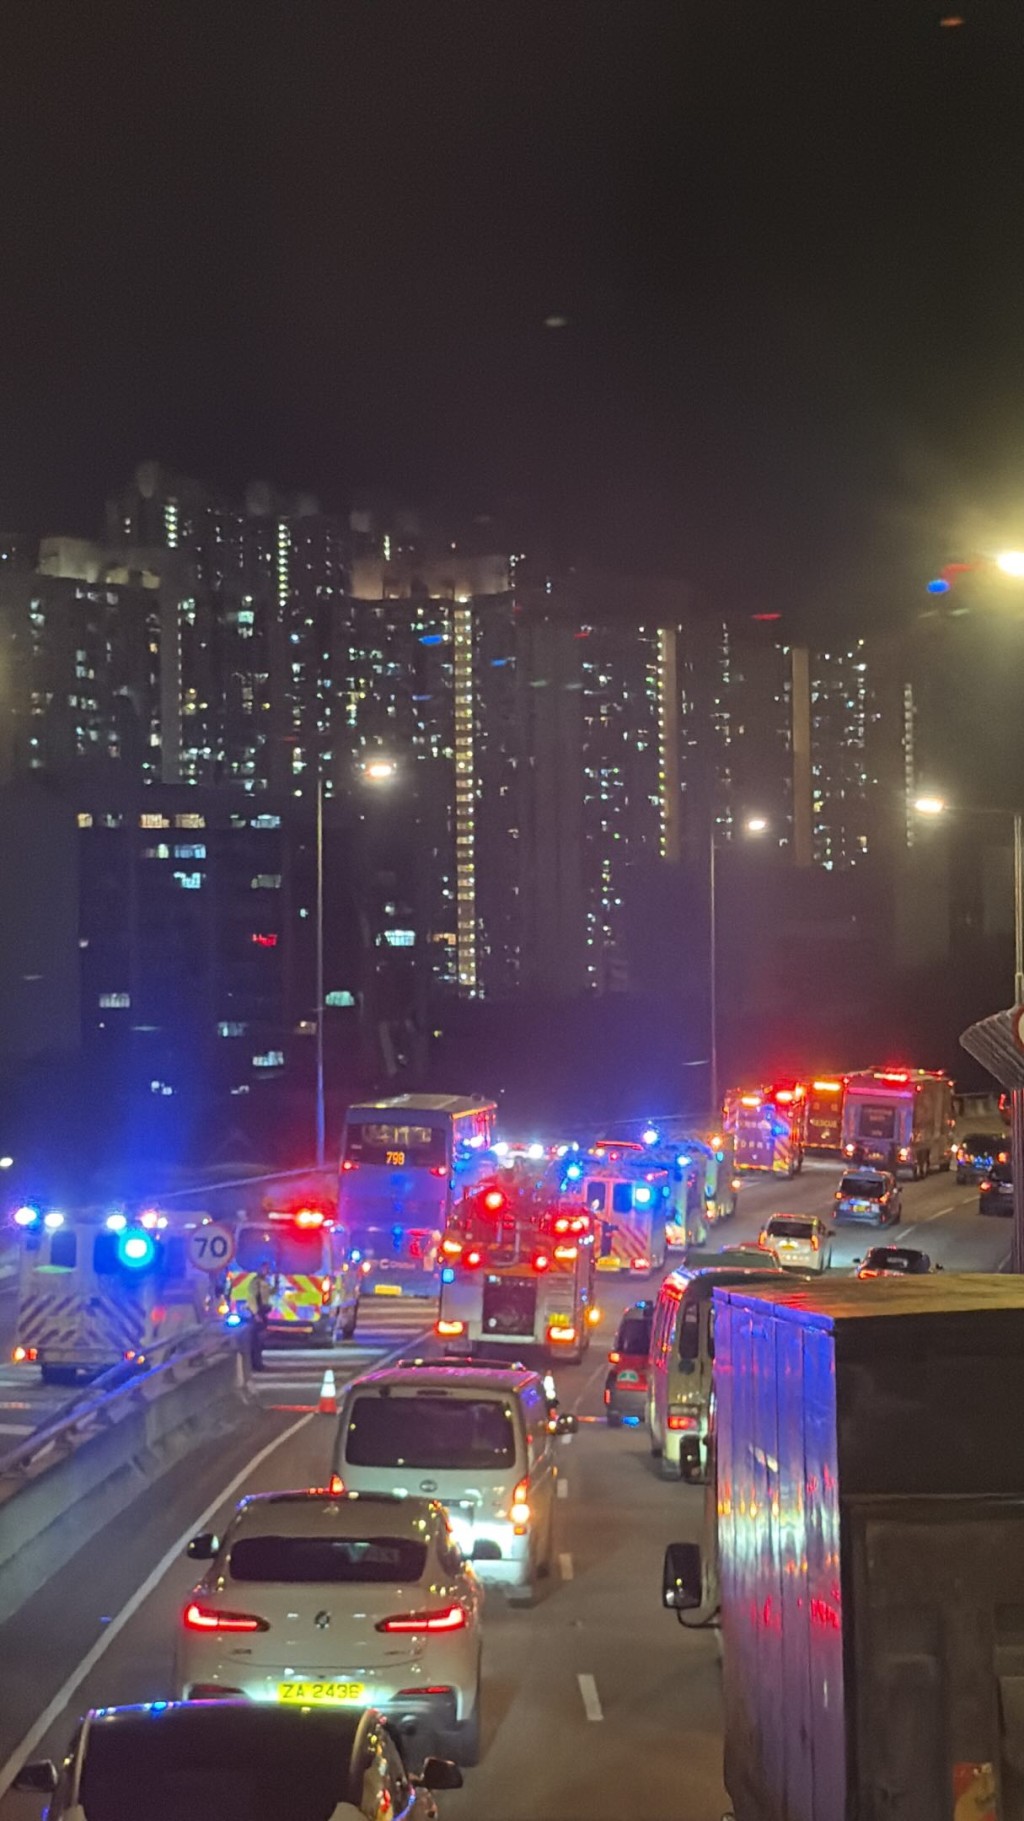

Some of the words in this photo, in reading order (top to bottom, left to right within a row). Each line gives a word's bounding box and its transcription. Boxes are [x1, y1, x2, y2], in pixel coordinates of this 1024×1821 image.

[386, 1151, 405, 1165] 798
[194, 1236, 227, 1258] 70
[282, 1684, 304, 1698] ZA
[312, 1684, 360, 1699] 2436
